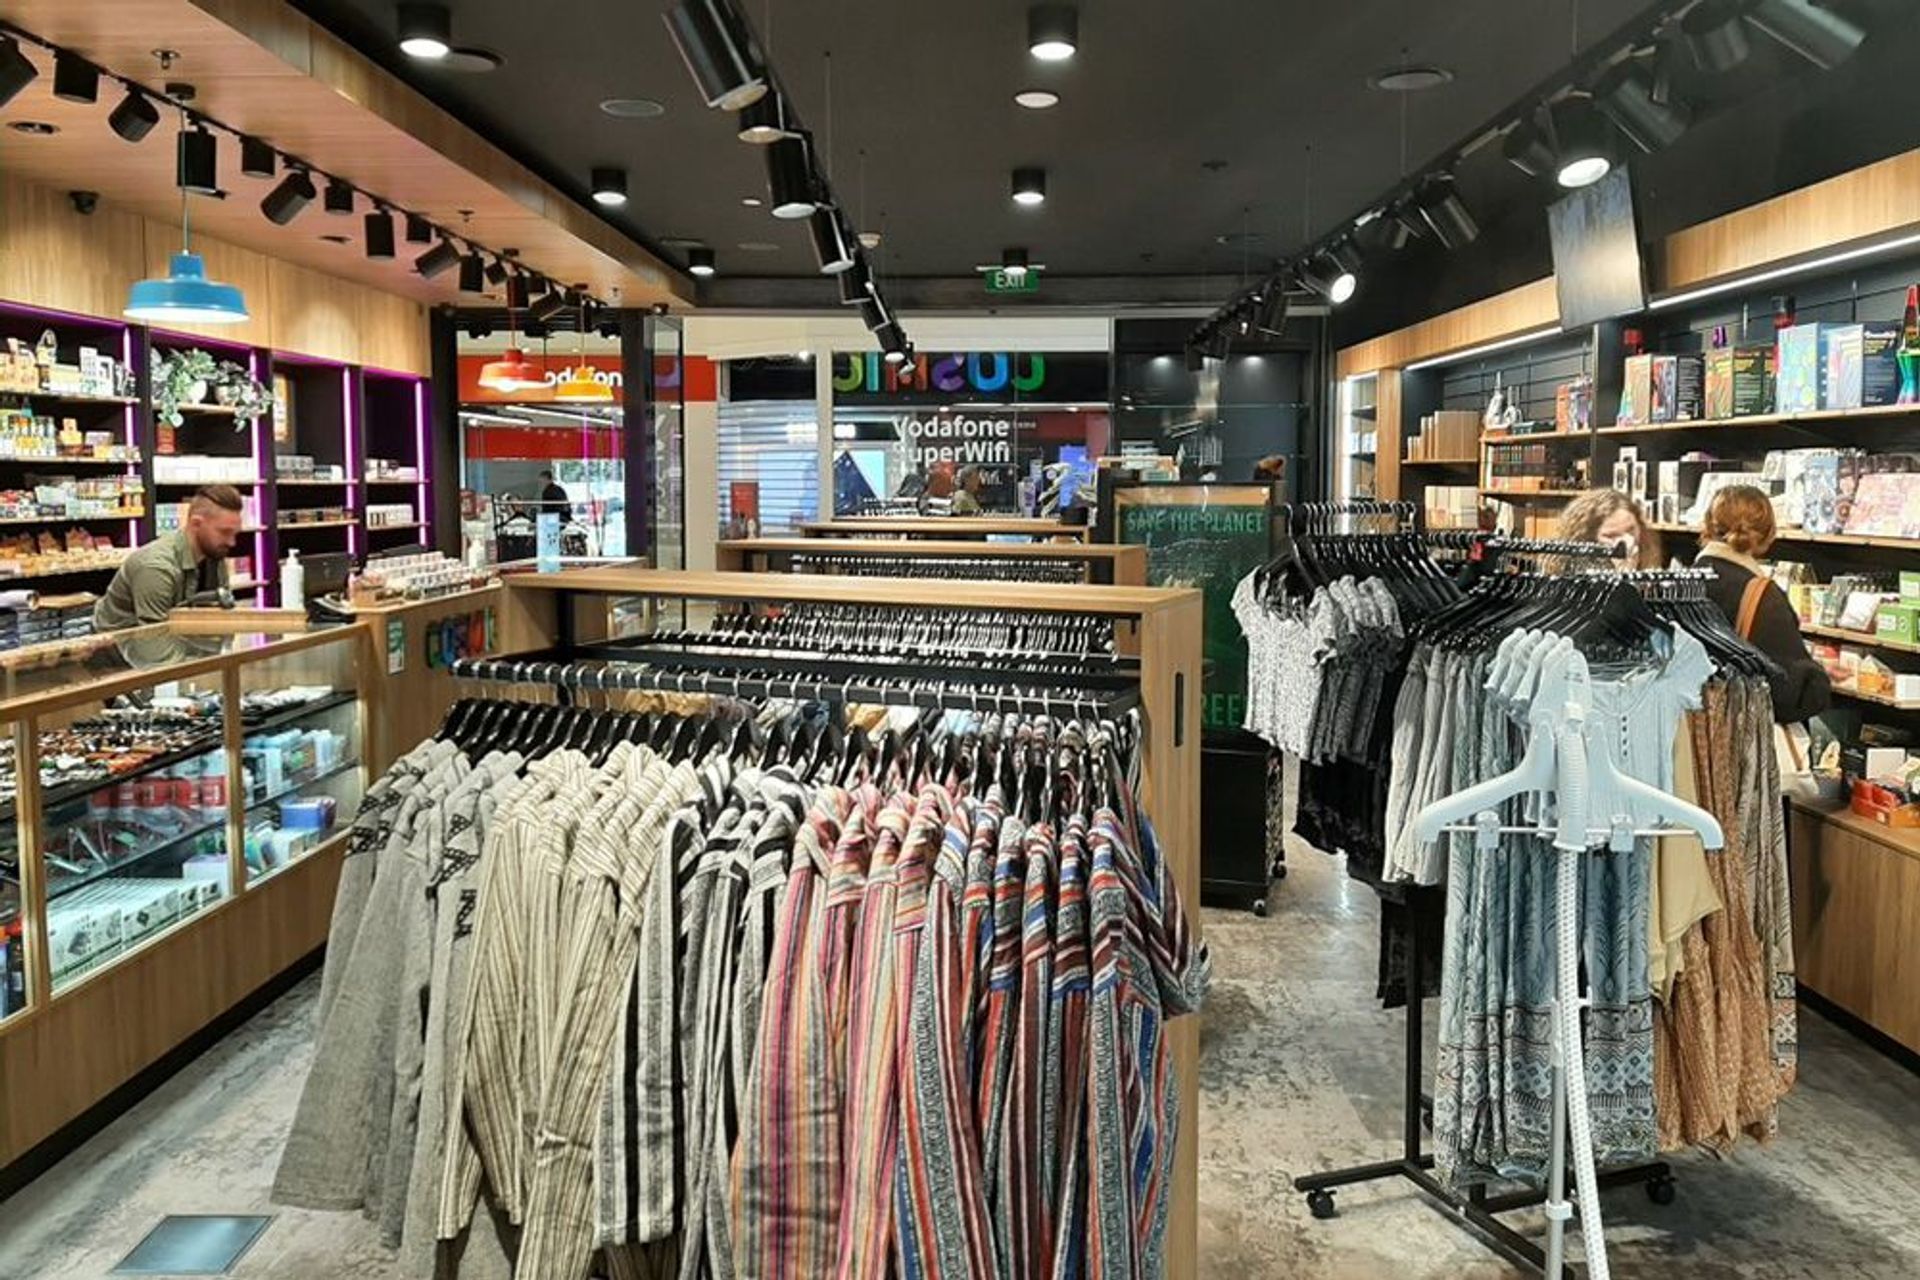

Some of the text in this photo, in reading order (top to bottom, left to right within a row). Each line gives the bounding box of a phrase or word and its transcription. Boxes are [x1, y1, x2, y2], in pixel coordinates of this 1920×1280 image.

[995, 270, 1025, 288] EXIT
[892, 415, 1010, 438] Vodafone
[1127, 511, 1264, 533] SAVE THE PLANET
